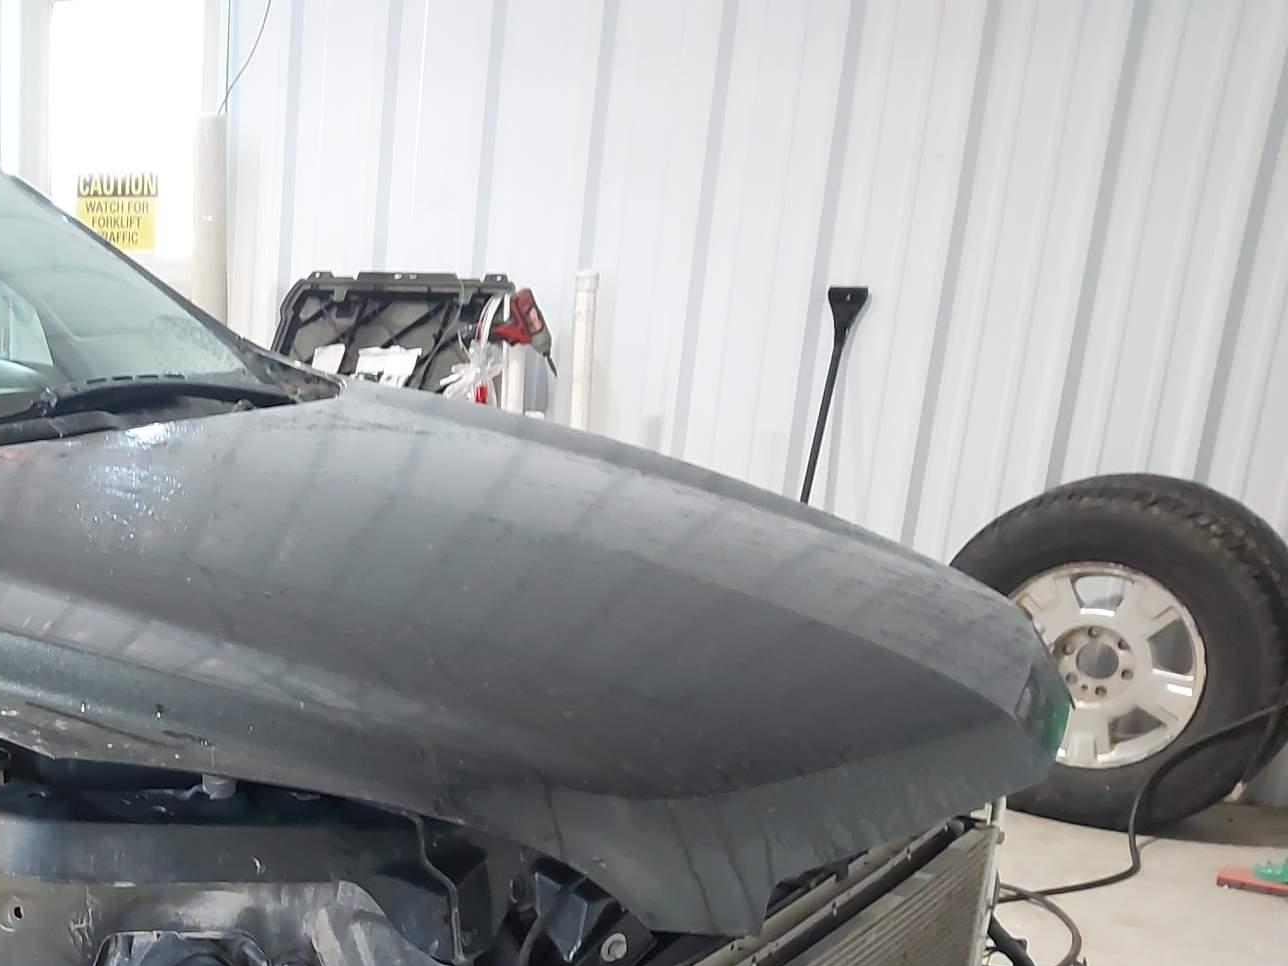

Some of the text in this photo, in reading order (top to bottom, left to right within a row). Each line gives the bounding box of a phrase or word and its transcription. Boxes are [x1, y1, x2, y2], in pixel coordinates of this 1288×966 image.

[79, 174, 158, 197] CAUTION
[85, 201, 150, 214] WATCH FOR
[92, 216, 142, 229] FORKLIFT
[101, 231, 139, 244] RAFFIC
